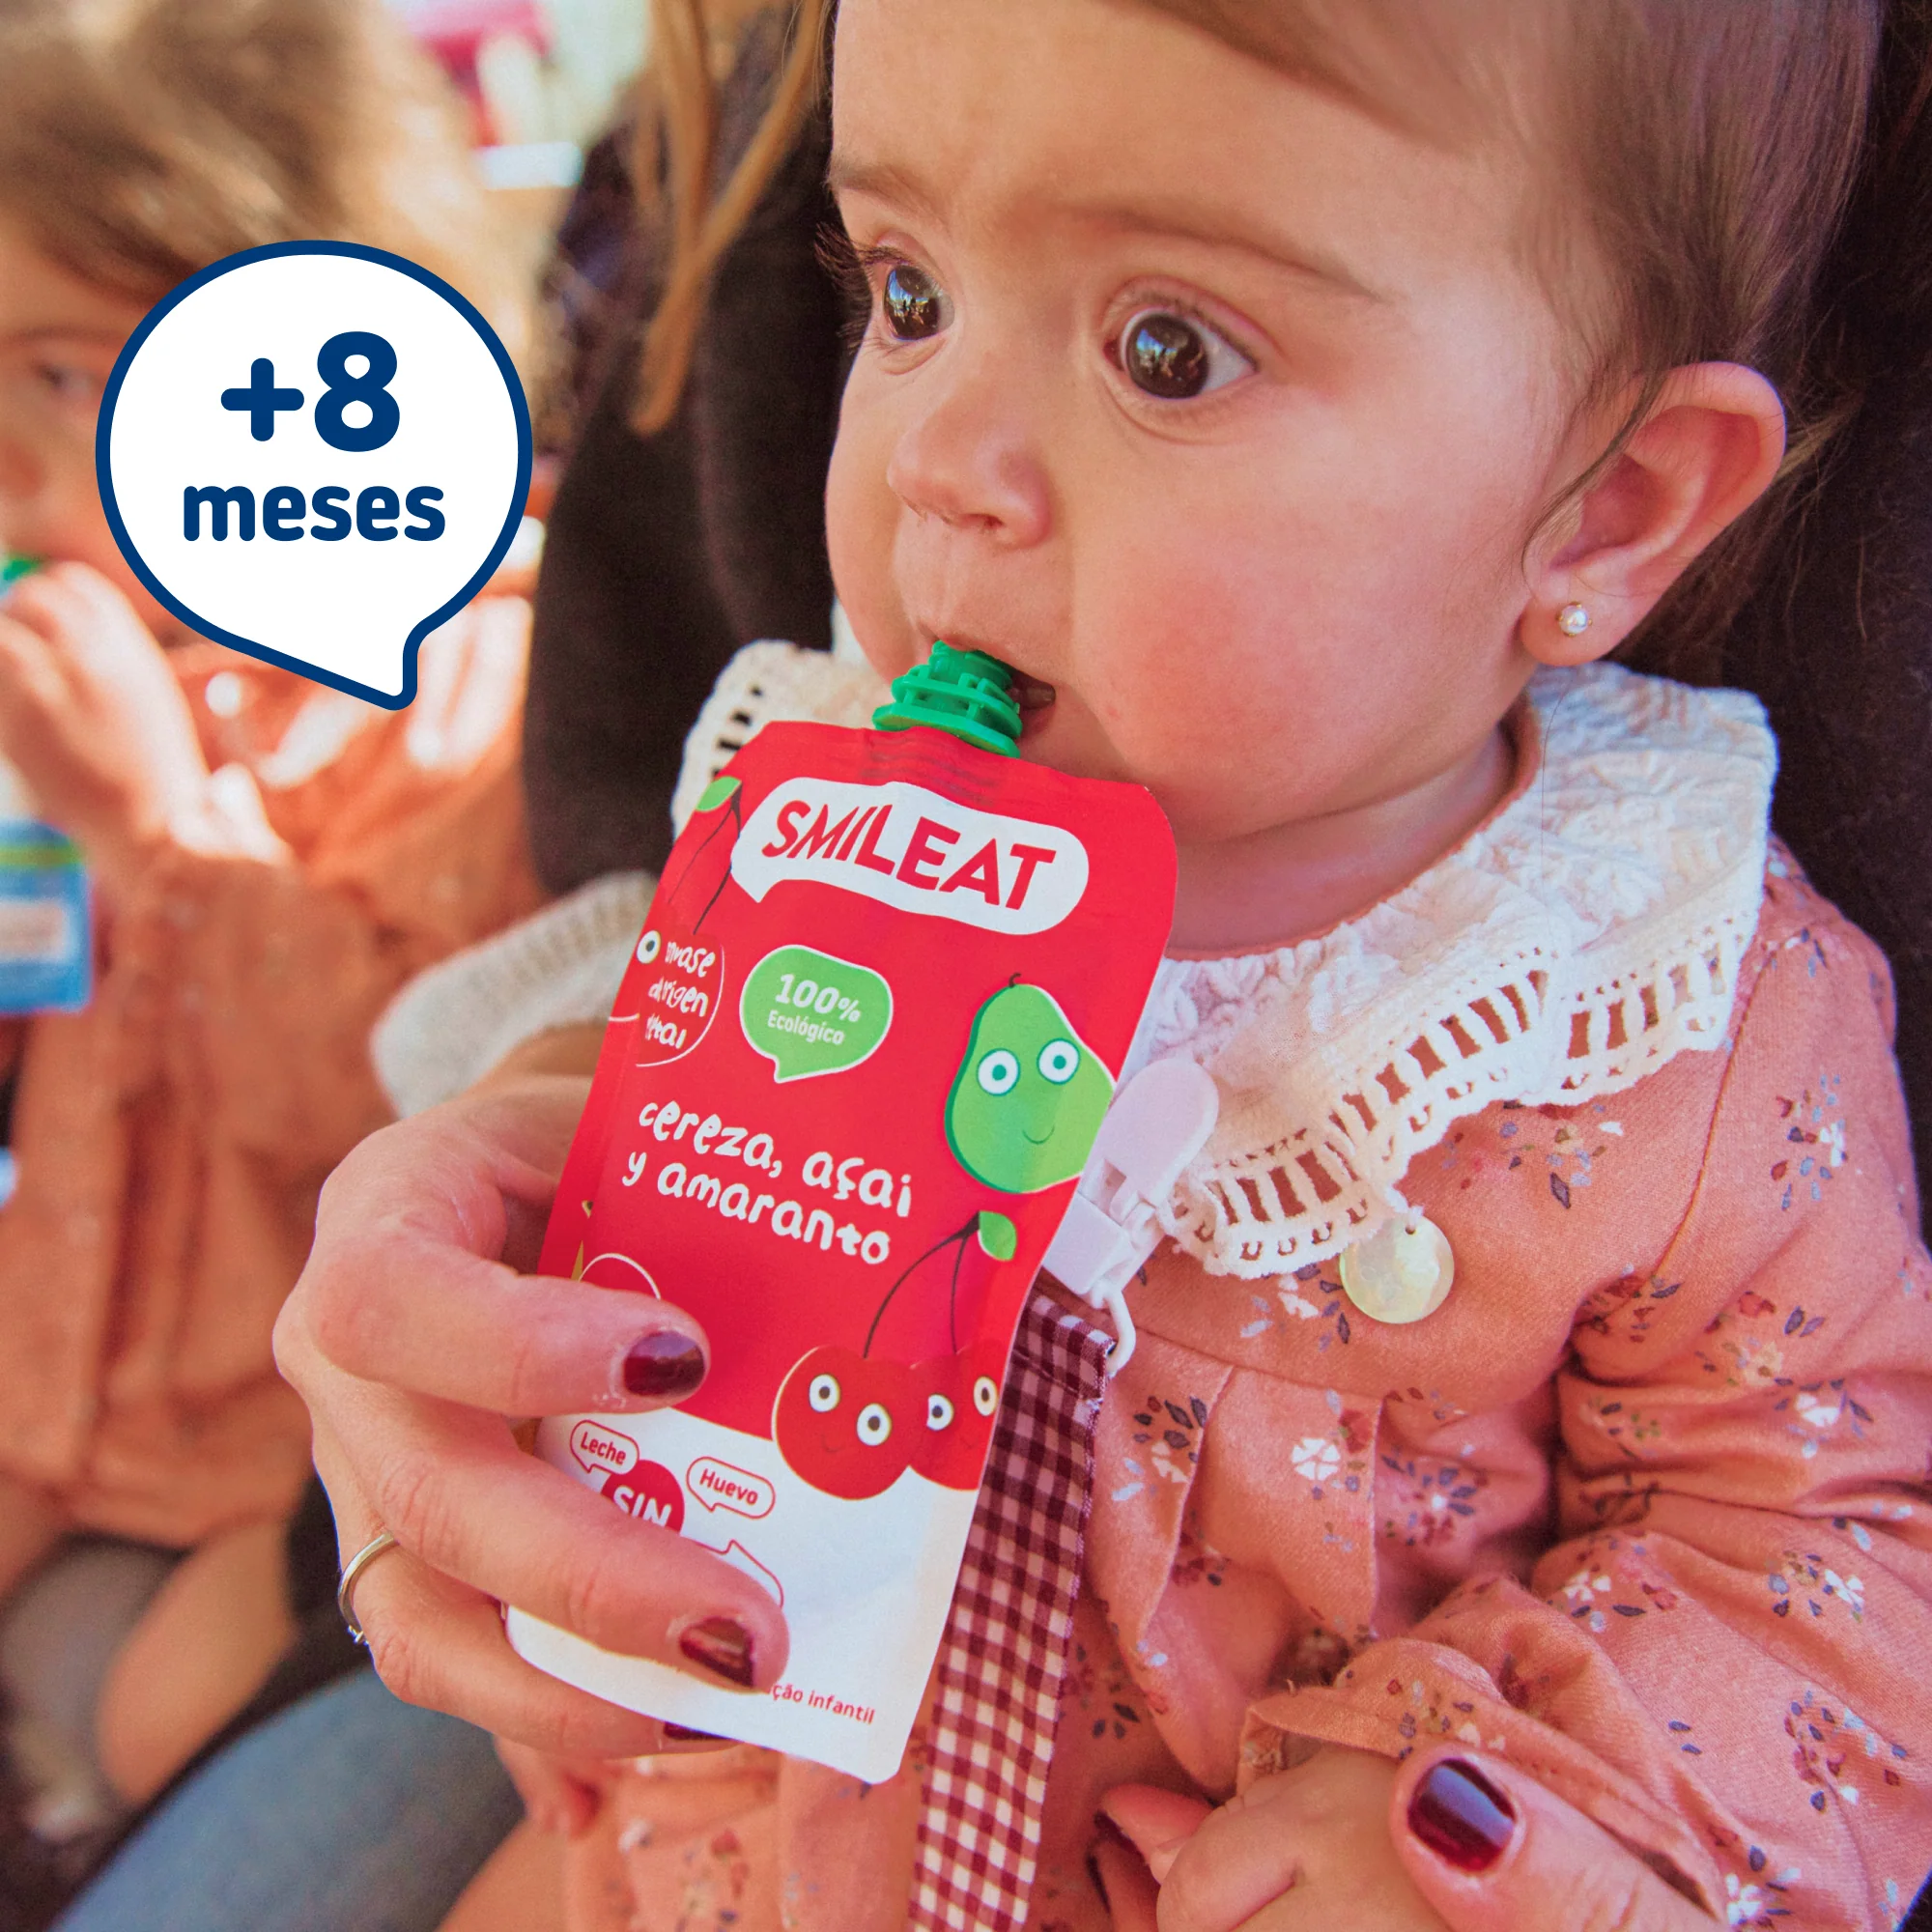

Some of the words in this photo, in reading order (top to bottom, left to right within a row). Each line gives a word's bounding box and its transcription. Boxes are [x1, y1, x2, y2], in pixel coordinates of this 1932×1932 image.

[761, 800, 1057, 911] SMILEAT
[775, 973, 862, 1023] 100%
[767, 1009, 846, 1046] Ecológico
[639, 1100, 782, 1179] cereza,
[621, 1151, 647, 1187] y
[657, 1162, 891, 1264] amaranto
[580, 1431, 627, 1466] Leche
[612, 1484, 672, 1528] SIN
[698, 1467, 759, 1507] Huevo
[771, 1683, 804, 1703] ção
[807, 1690, 875, 1725] infantil
